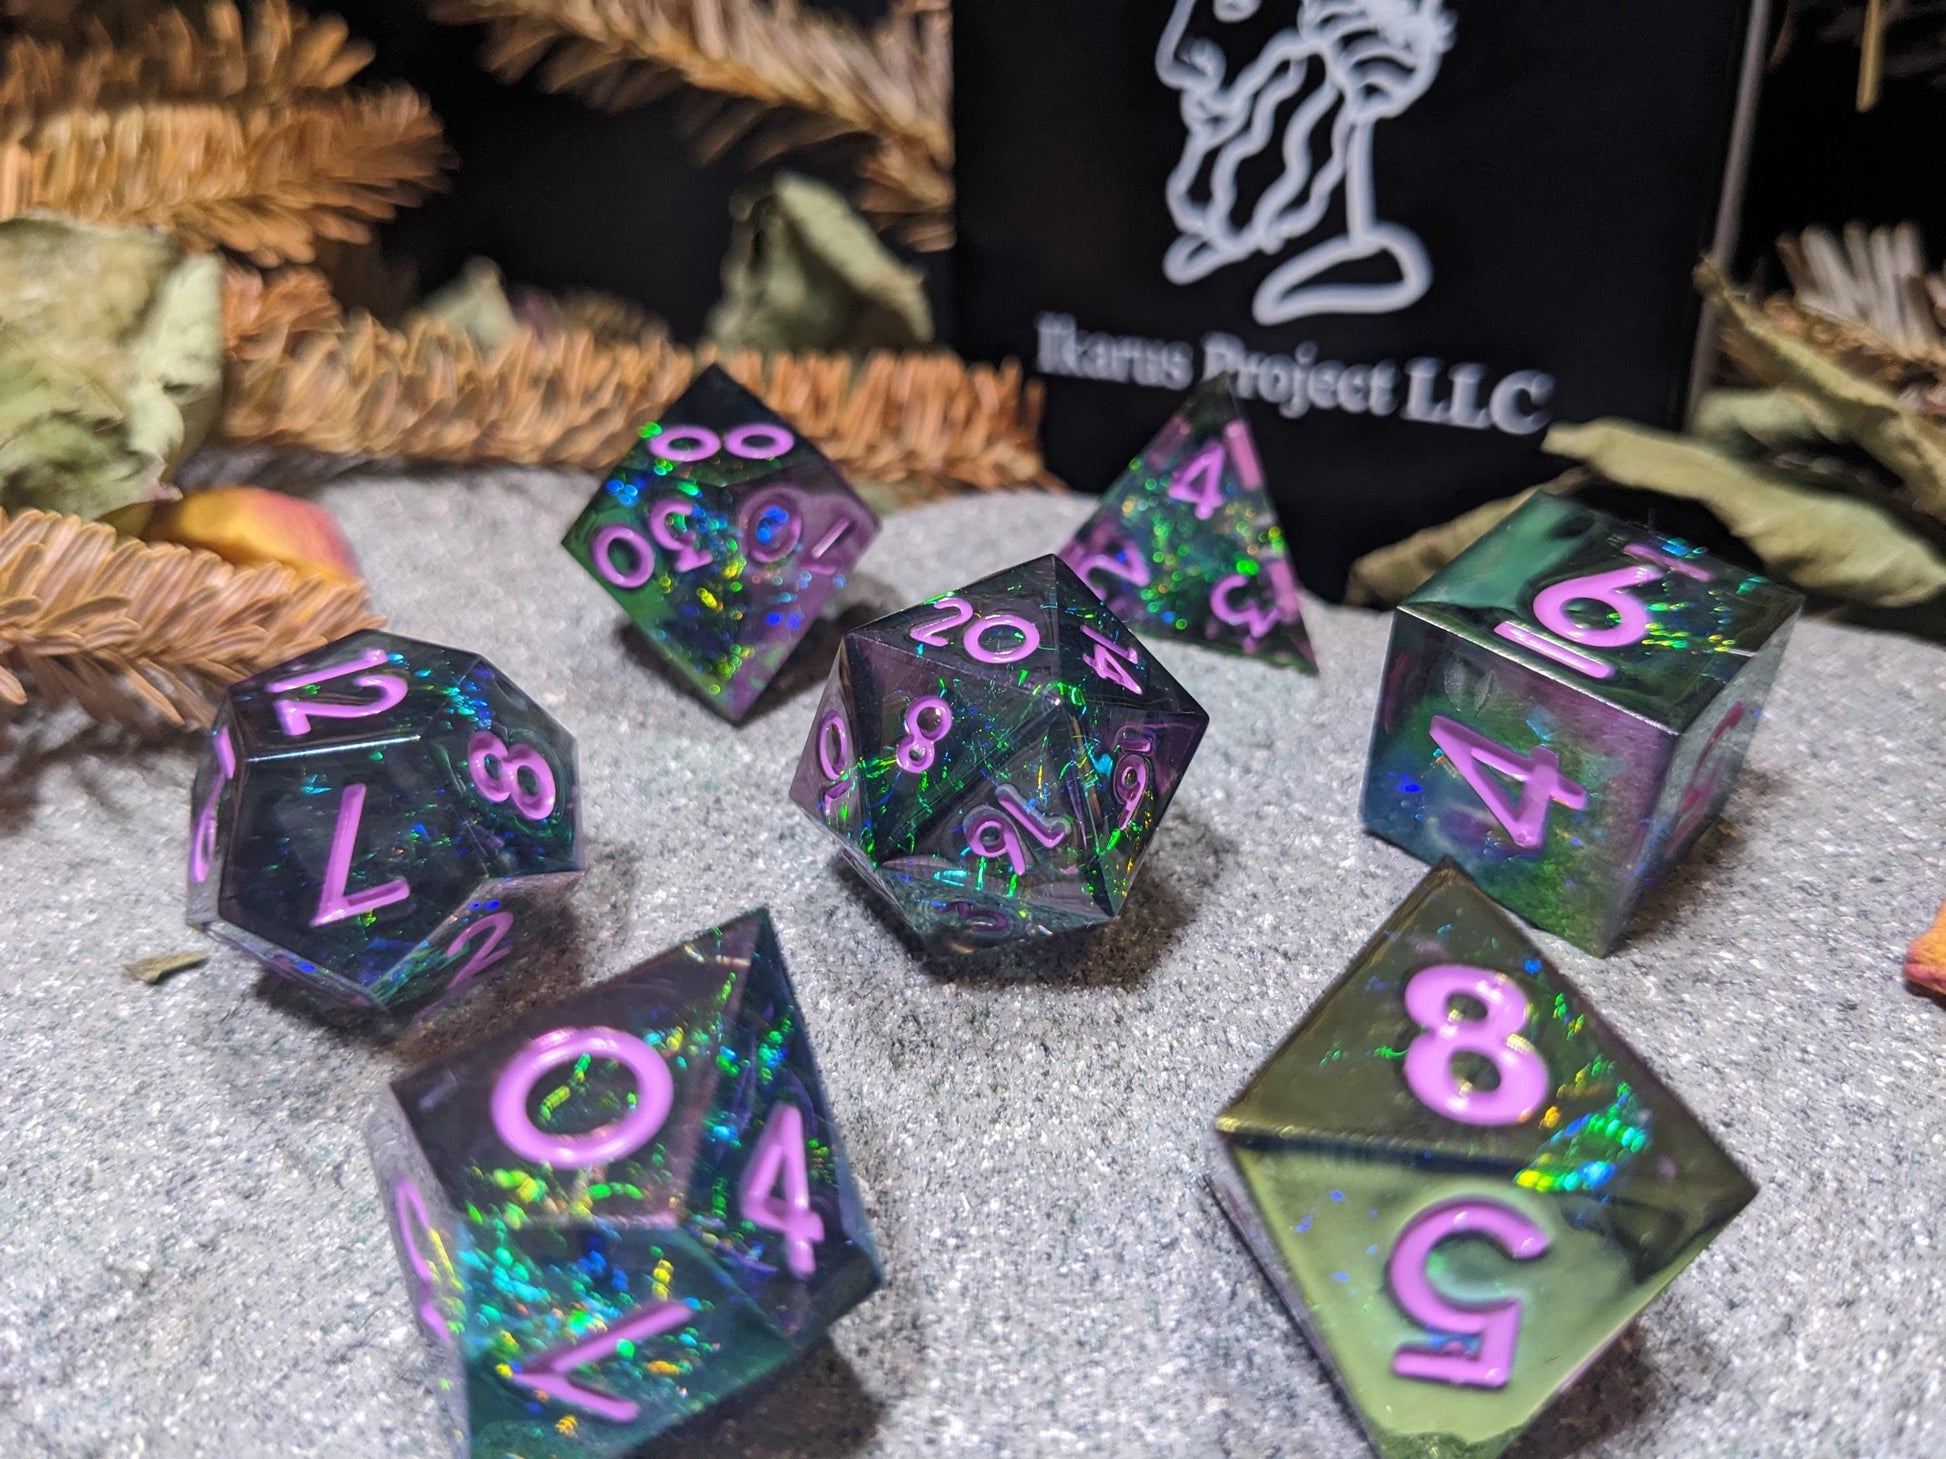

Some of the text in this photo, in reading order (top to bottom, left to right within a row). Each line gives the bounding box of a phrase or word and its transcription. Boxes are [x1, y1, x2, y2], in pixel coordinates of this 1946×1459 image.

[1037, 311, 1555, 435] Ikarus Project LLC
[650, 423, 796, 463] 00
[1168, 440, 1228, 519] 4
[910, 598, 1040, 664] 20
[1080, 624, 1142, 695] 14
[267, 649, 408, 737] 12
[896, 695, 952, 774] 8
[467, 730, 556, 820] 8
[1428, 715, 1588, 850] 4
[310, 783, 410, 927] 7
[963, 783, 1070, 876] 16
[446, 911, 514, 988] 2
[1404, 964, 1549, 1126] 8
[491, 1026, 674, 1169] 0
[741, 1103, 825, 1275] 4
[1388, 1196, 1549, 1389] 5
[510, 1300, 698, 1422] 7
